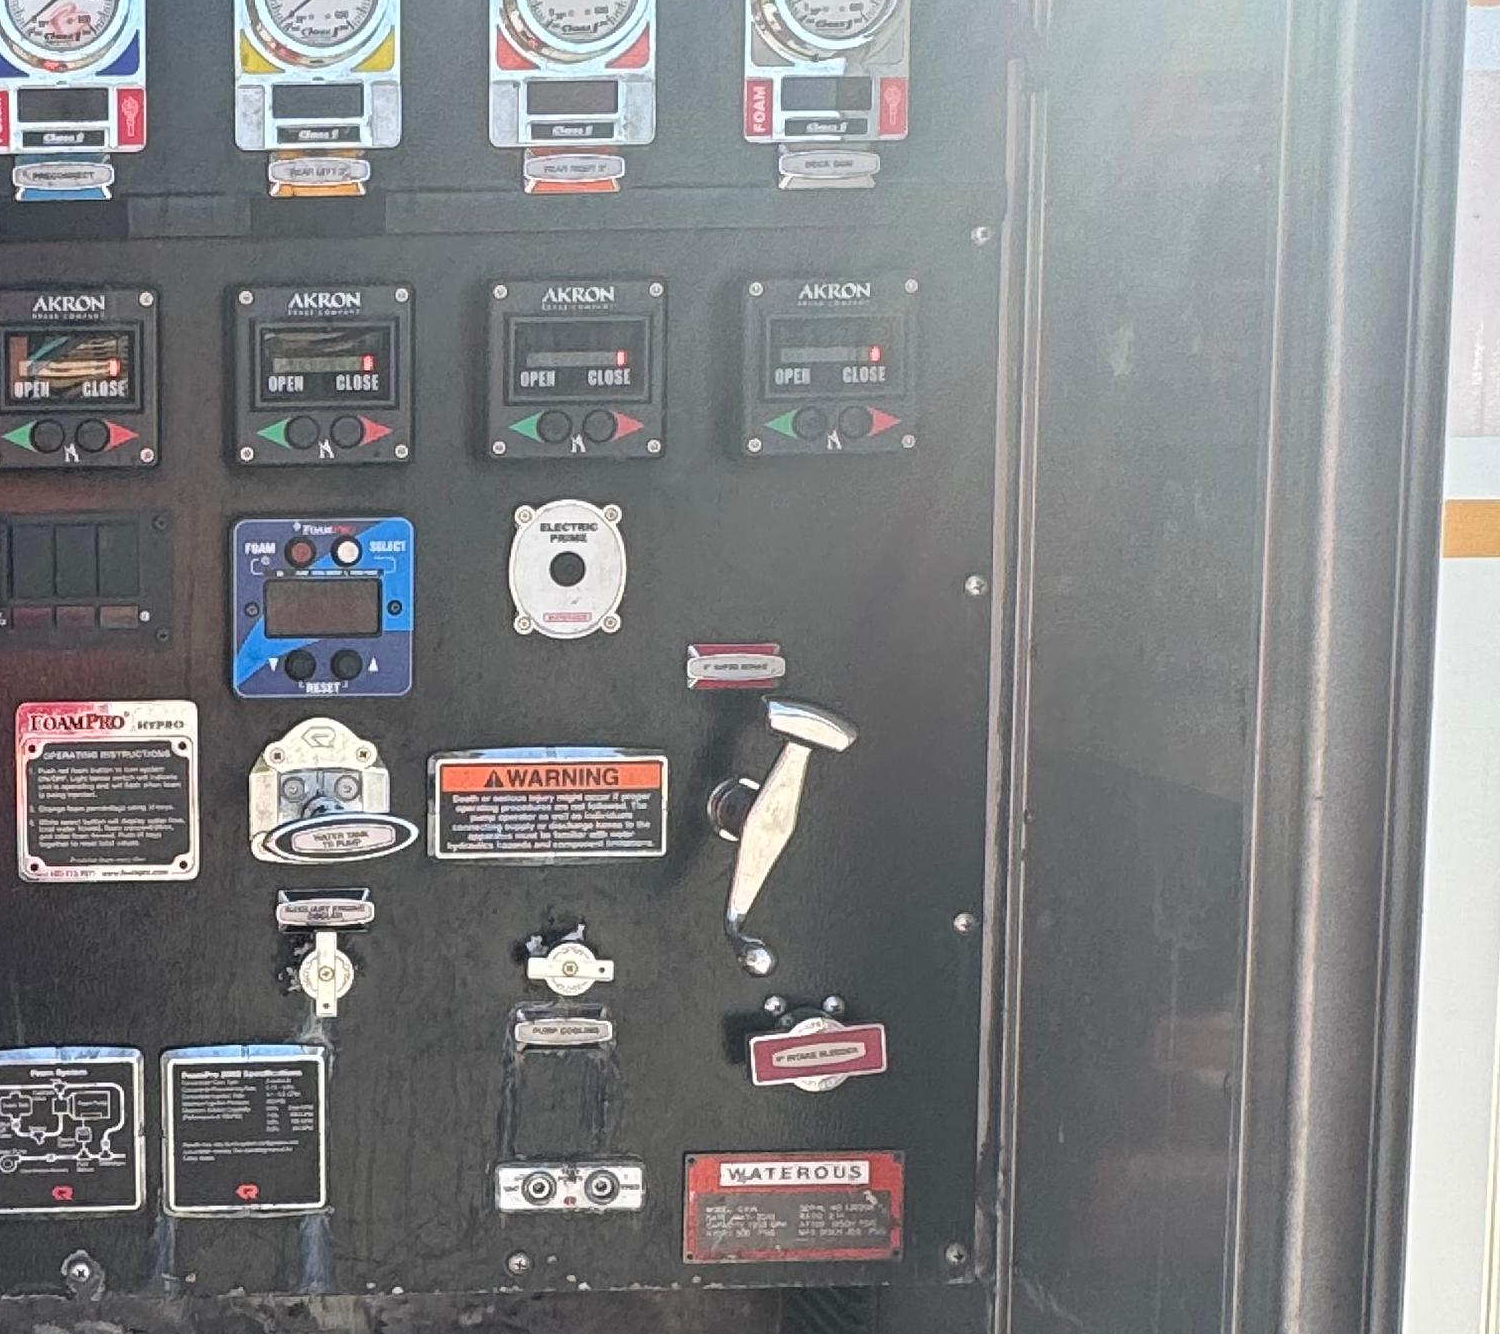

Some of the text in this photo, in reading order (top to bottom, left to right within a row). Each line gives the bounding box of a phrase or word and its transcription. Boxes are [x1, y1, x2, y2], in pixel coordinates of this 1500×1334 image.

[753, 87, 766, 133] FOAM
[542, 286, 614, 303] AKRON
[799, 283, 871, 299] AKRON
[32, 295, 105, 312] AKRON
[288, 292, 361, 308] AKRON
[336, 374, 379, 391] CLOSE
[520, 371, 556, 388] OPEN
[588, 369, 631, 386] CLOSE
[775, 368, 811, 385] OPEN
[842, 366, 886, 383] CLOSE
[14, 381, 50, 398] OPEN
[82, 380, 125, 397] CLOSE
[268, 375, 304, 392] OPEN
[540, 523, 598, 532] ELECTRIC
[370, 541, 405, 552] SELECT
[550, 534, 587, 543] PRIME
[245, 543, 276, 554] FOAM
[306, 683, 340, 693] RESET
[507, 768, 620, 787] WARNING
[728, 1165, 862, 1182] WATEROUS
